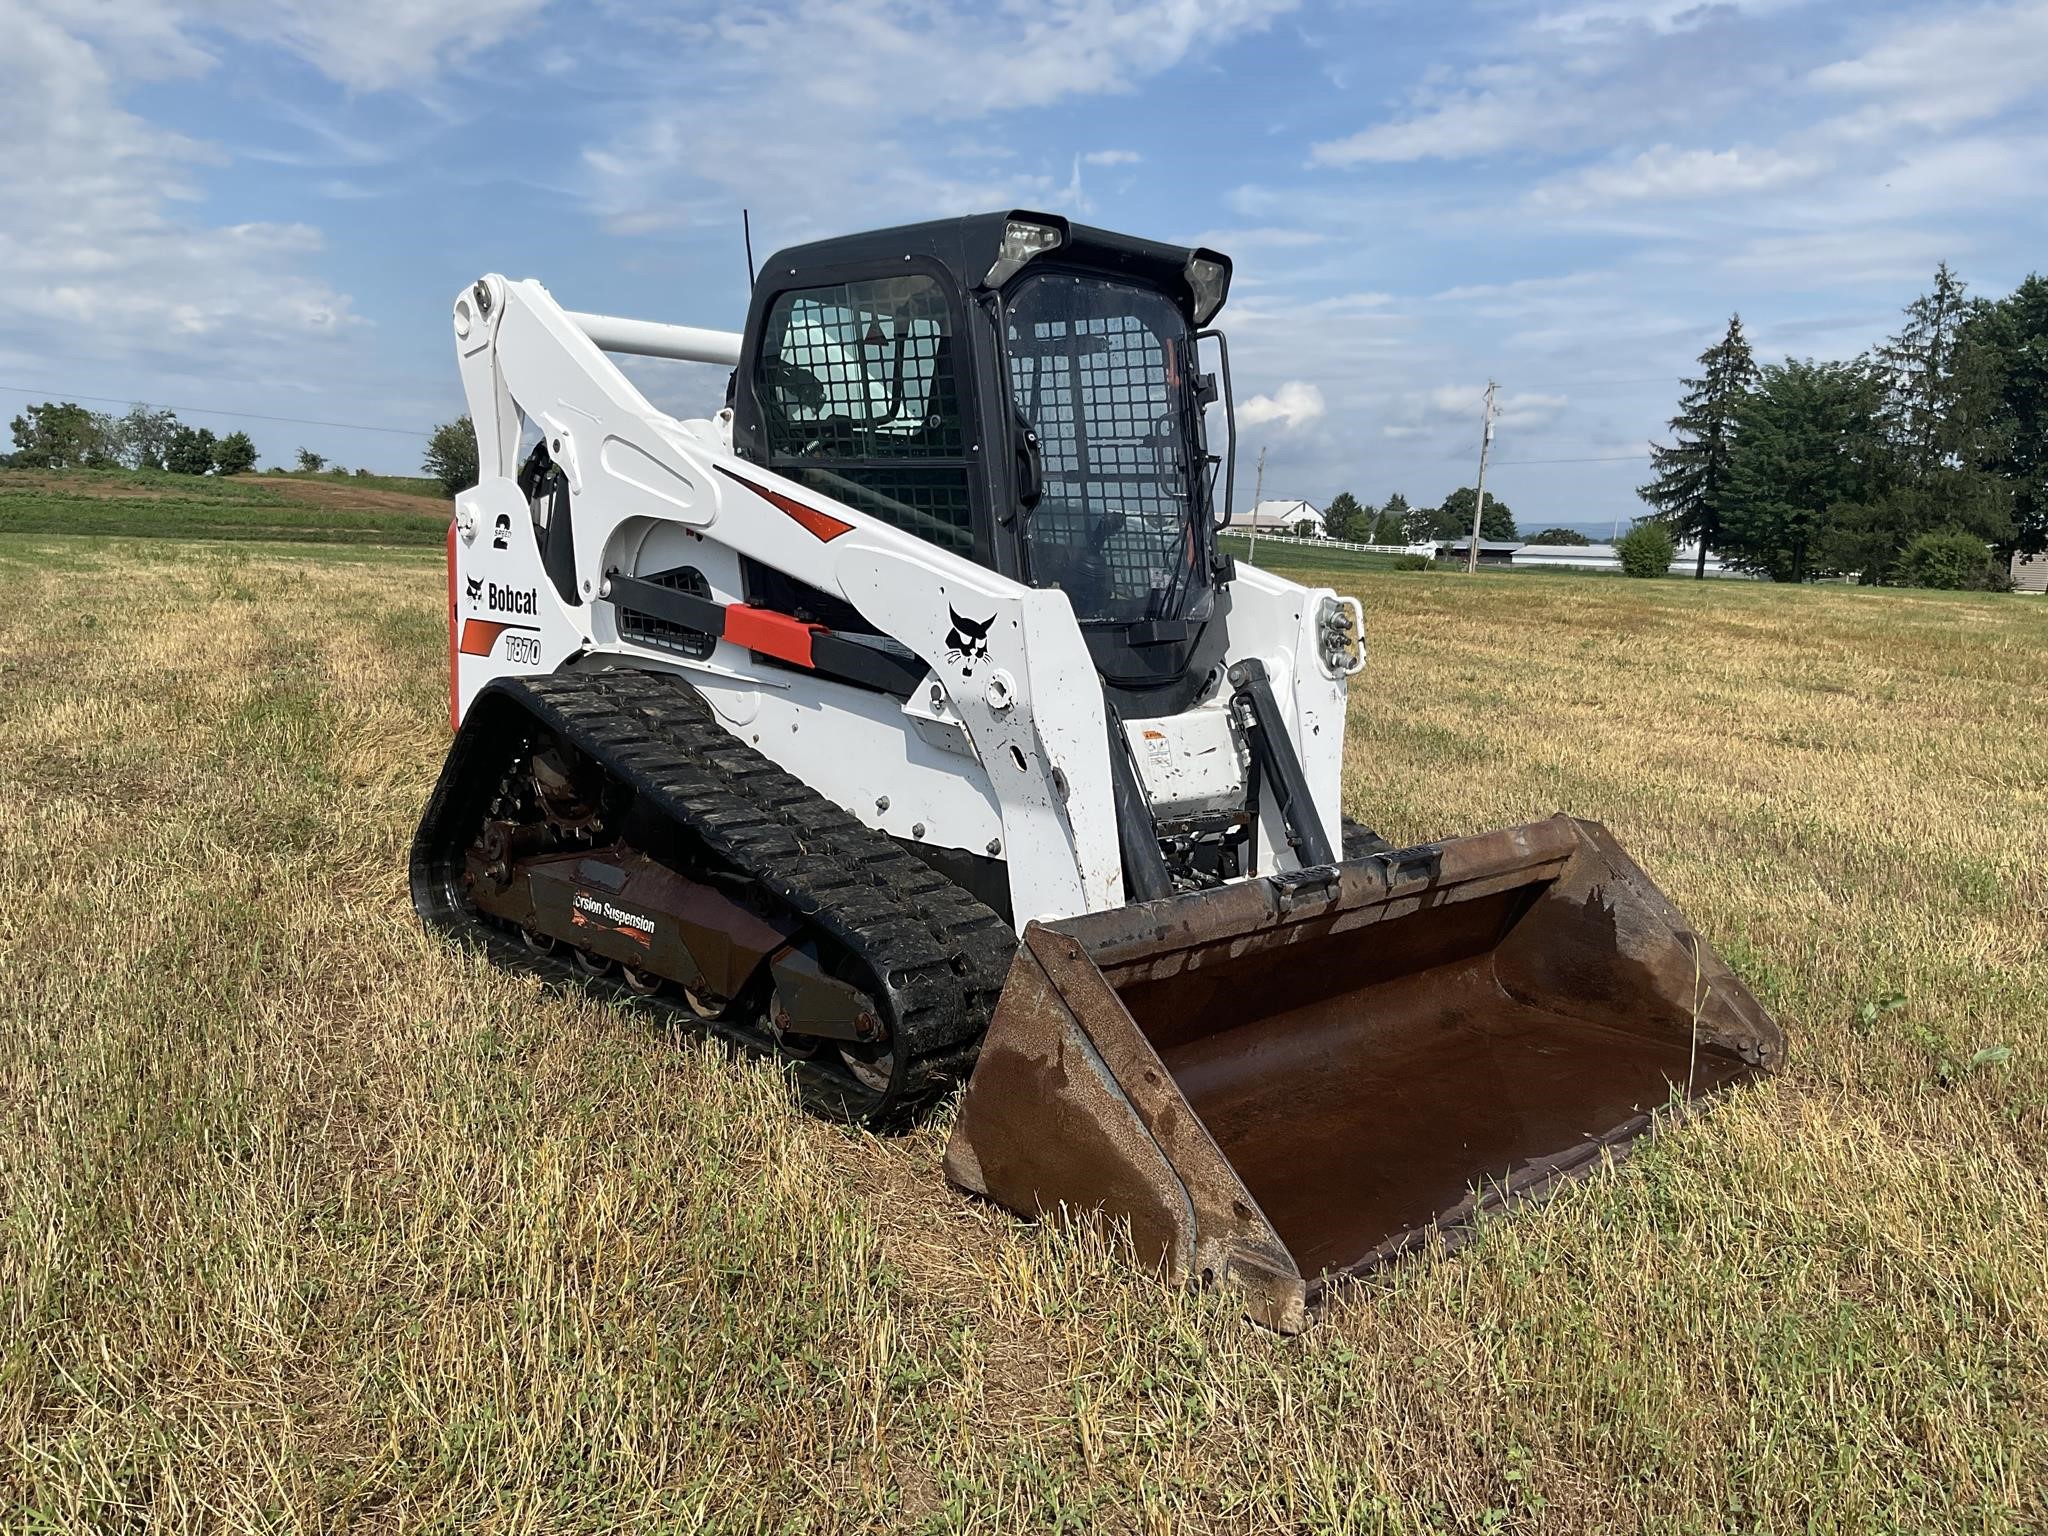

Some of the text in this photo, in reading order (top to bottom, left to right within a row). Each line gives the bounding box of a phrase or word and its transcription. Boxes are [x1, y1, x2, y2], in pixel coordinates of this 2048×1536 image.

[493, 513, 511, 550] 2
[494, 529, 512, 538] SPEED
[488, 582, 537, 615] Bobcat
[505, 635, 541, 666] T870
[573, 895, 655, 934] orsion Suspension
